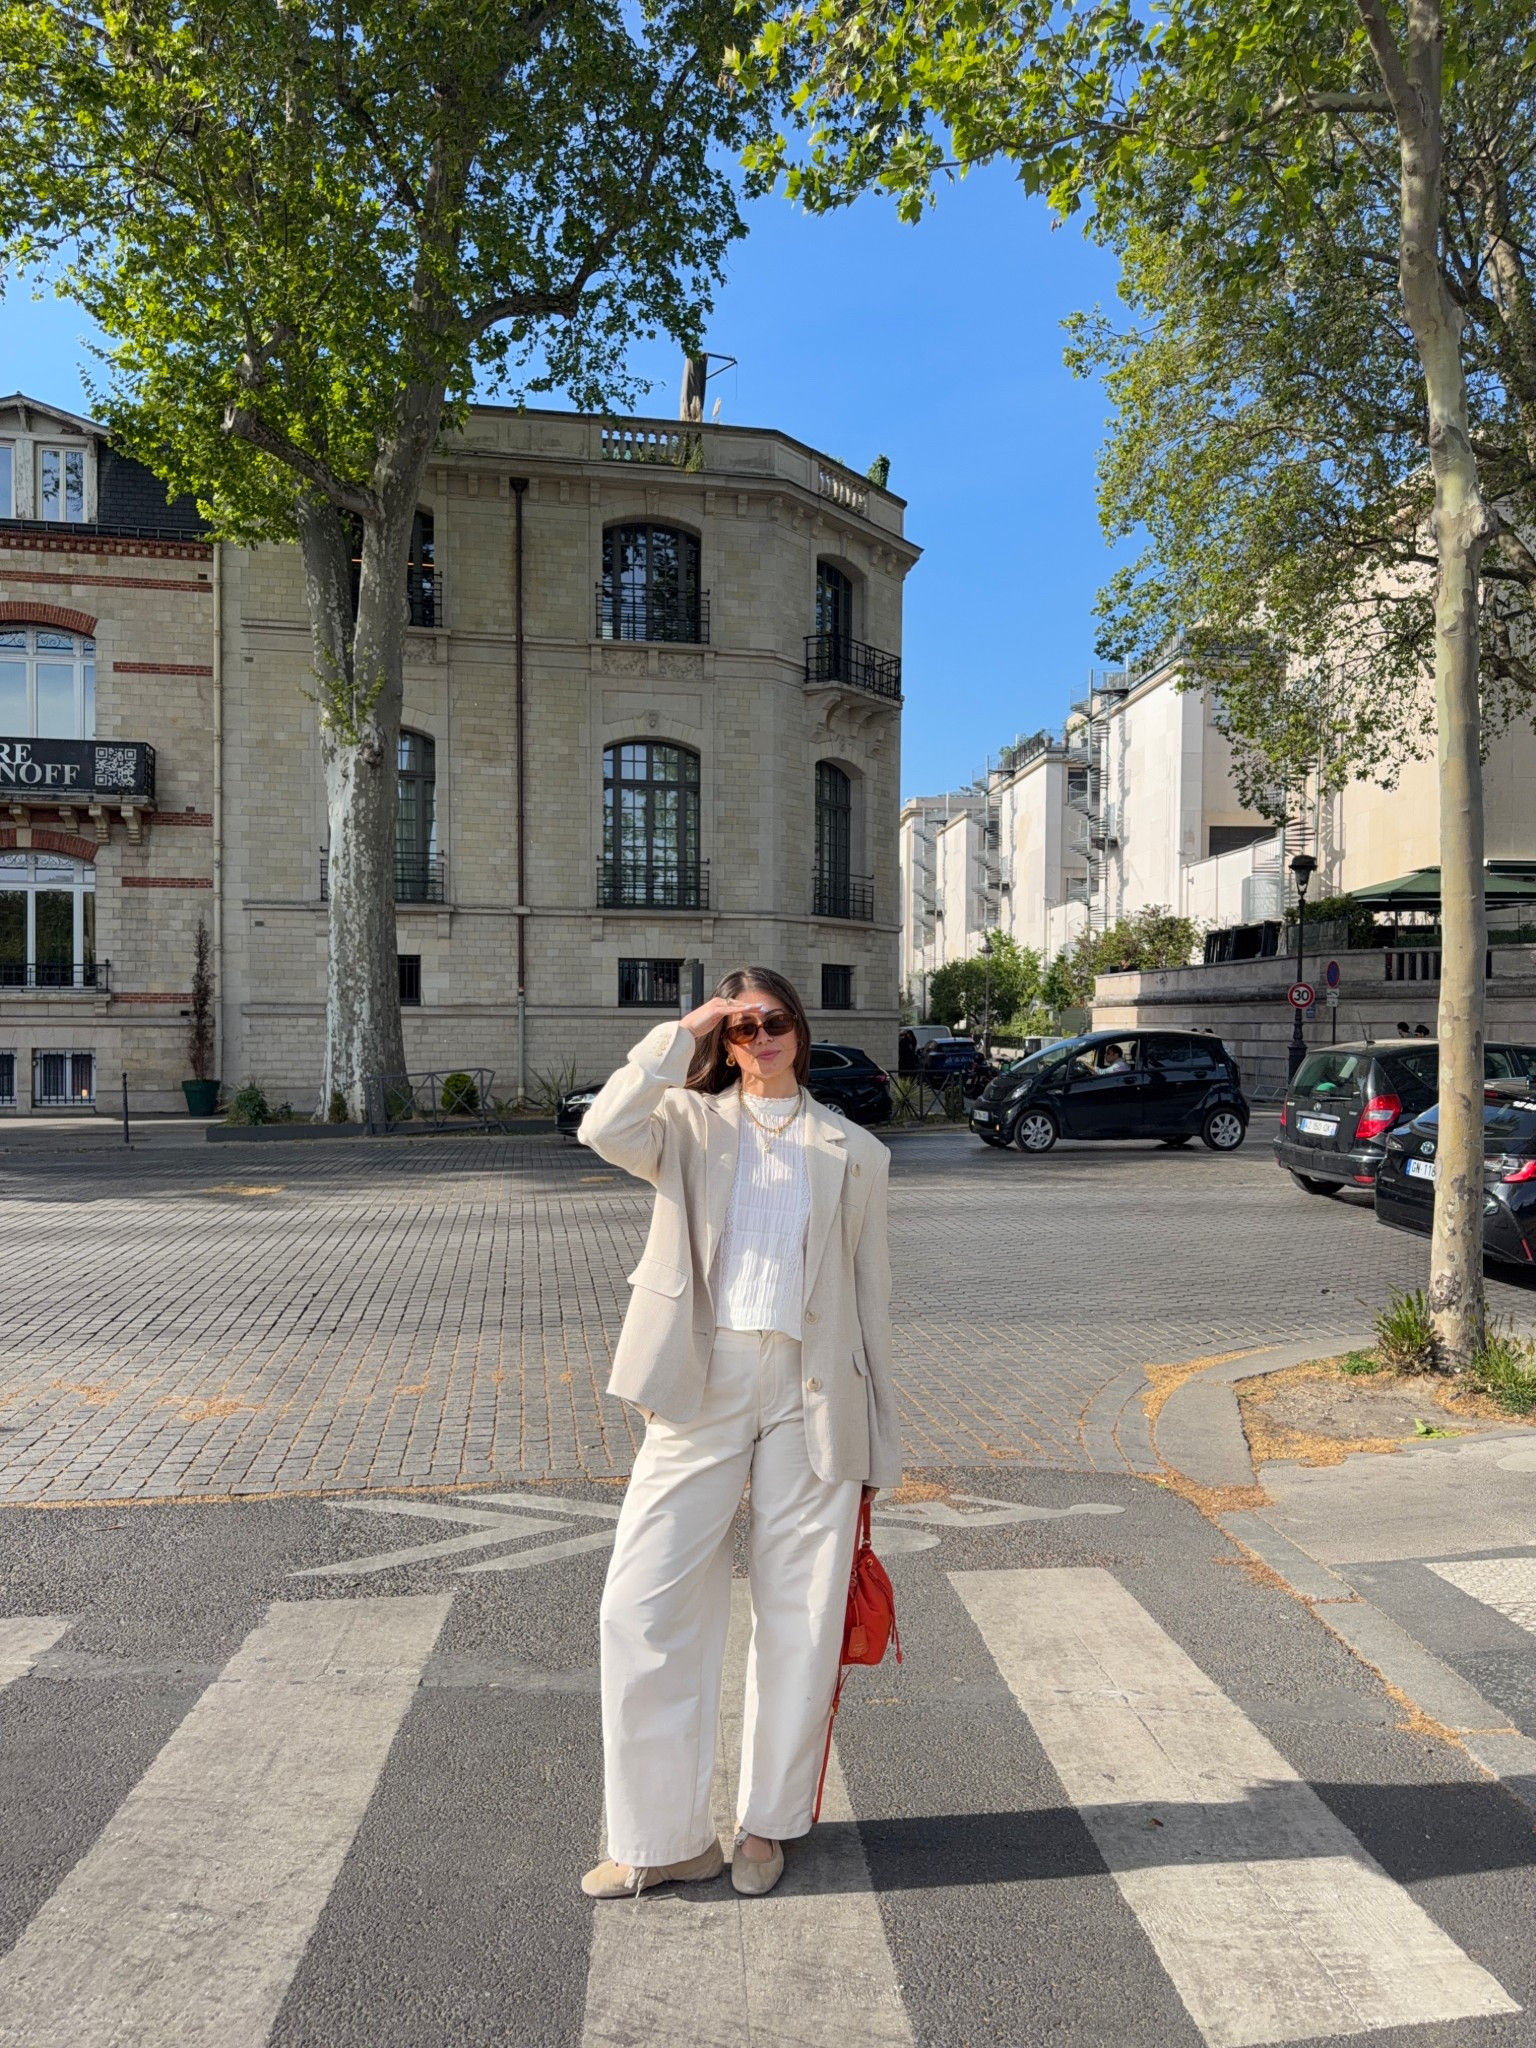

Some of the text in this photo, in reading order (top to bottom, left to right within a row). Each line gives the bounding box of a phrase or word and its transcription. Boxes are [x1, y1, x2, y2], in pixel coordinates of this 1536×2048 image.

[0, 743, 32, 764] RE
[0, 762, 80, 785] NOFF
[1294, 989, 1310, 1001] 30
